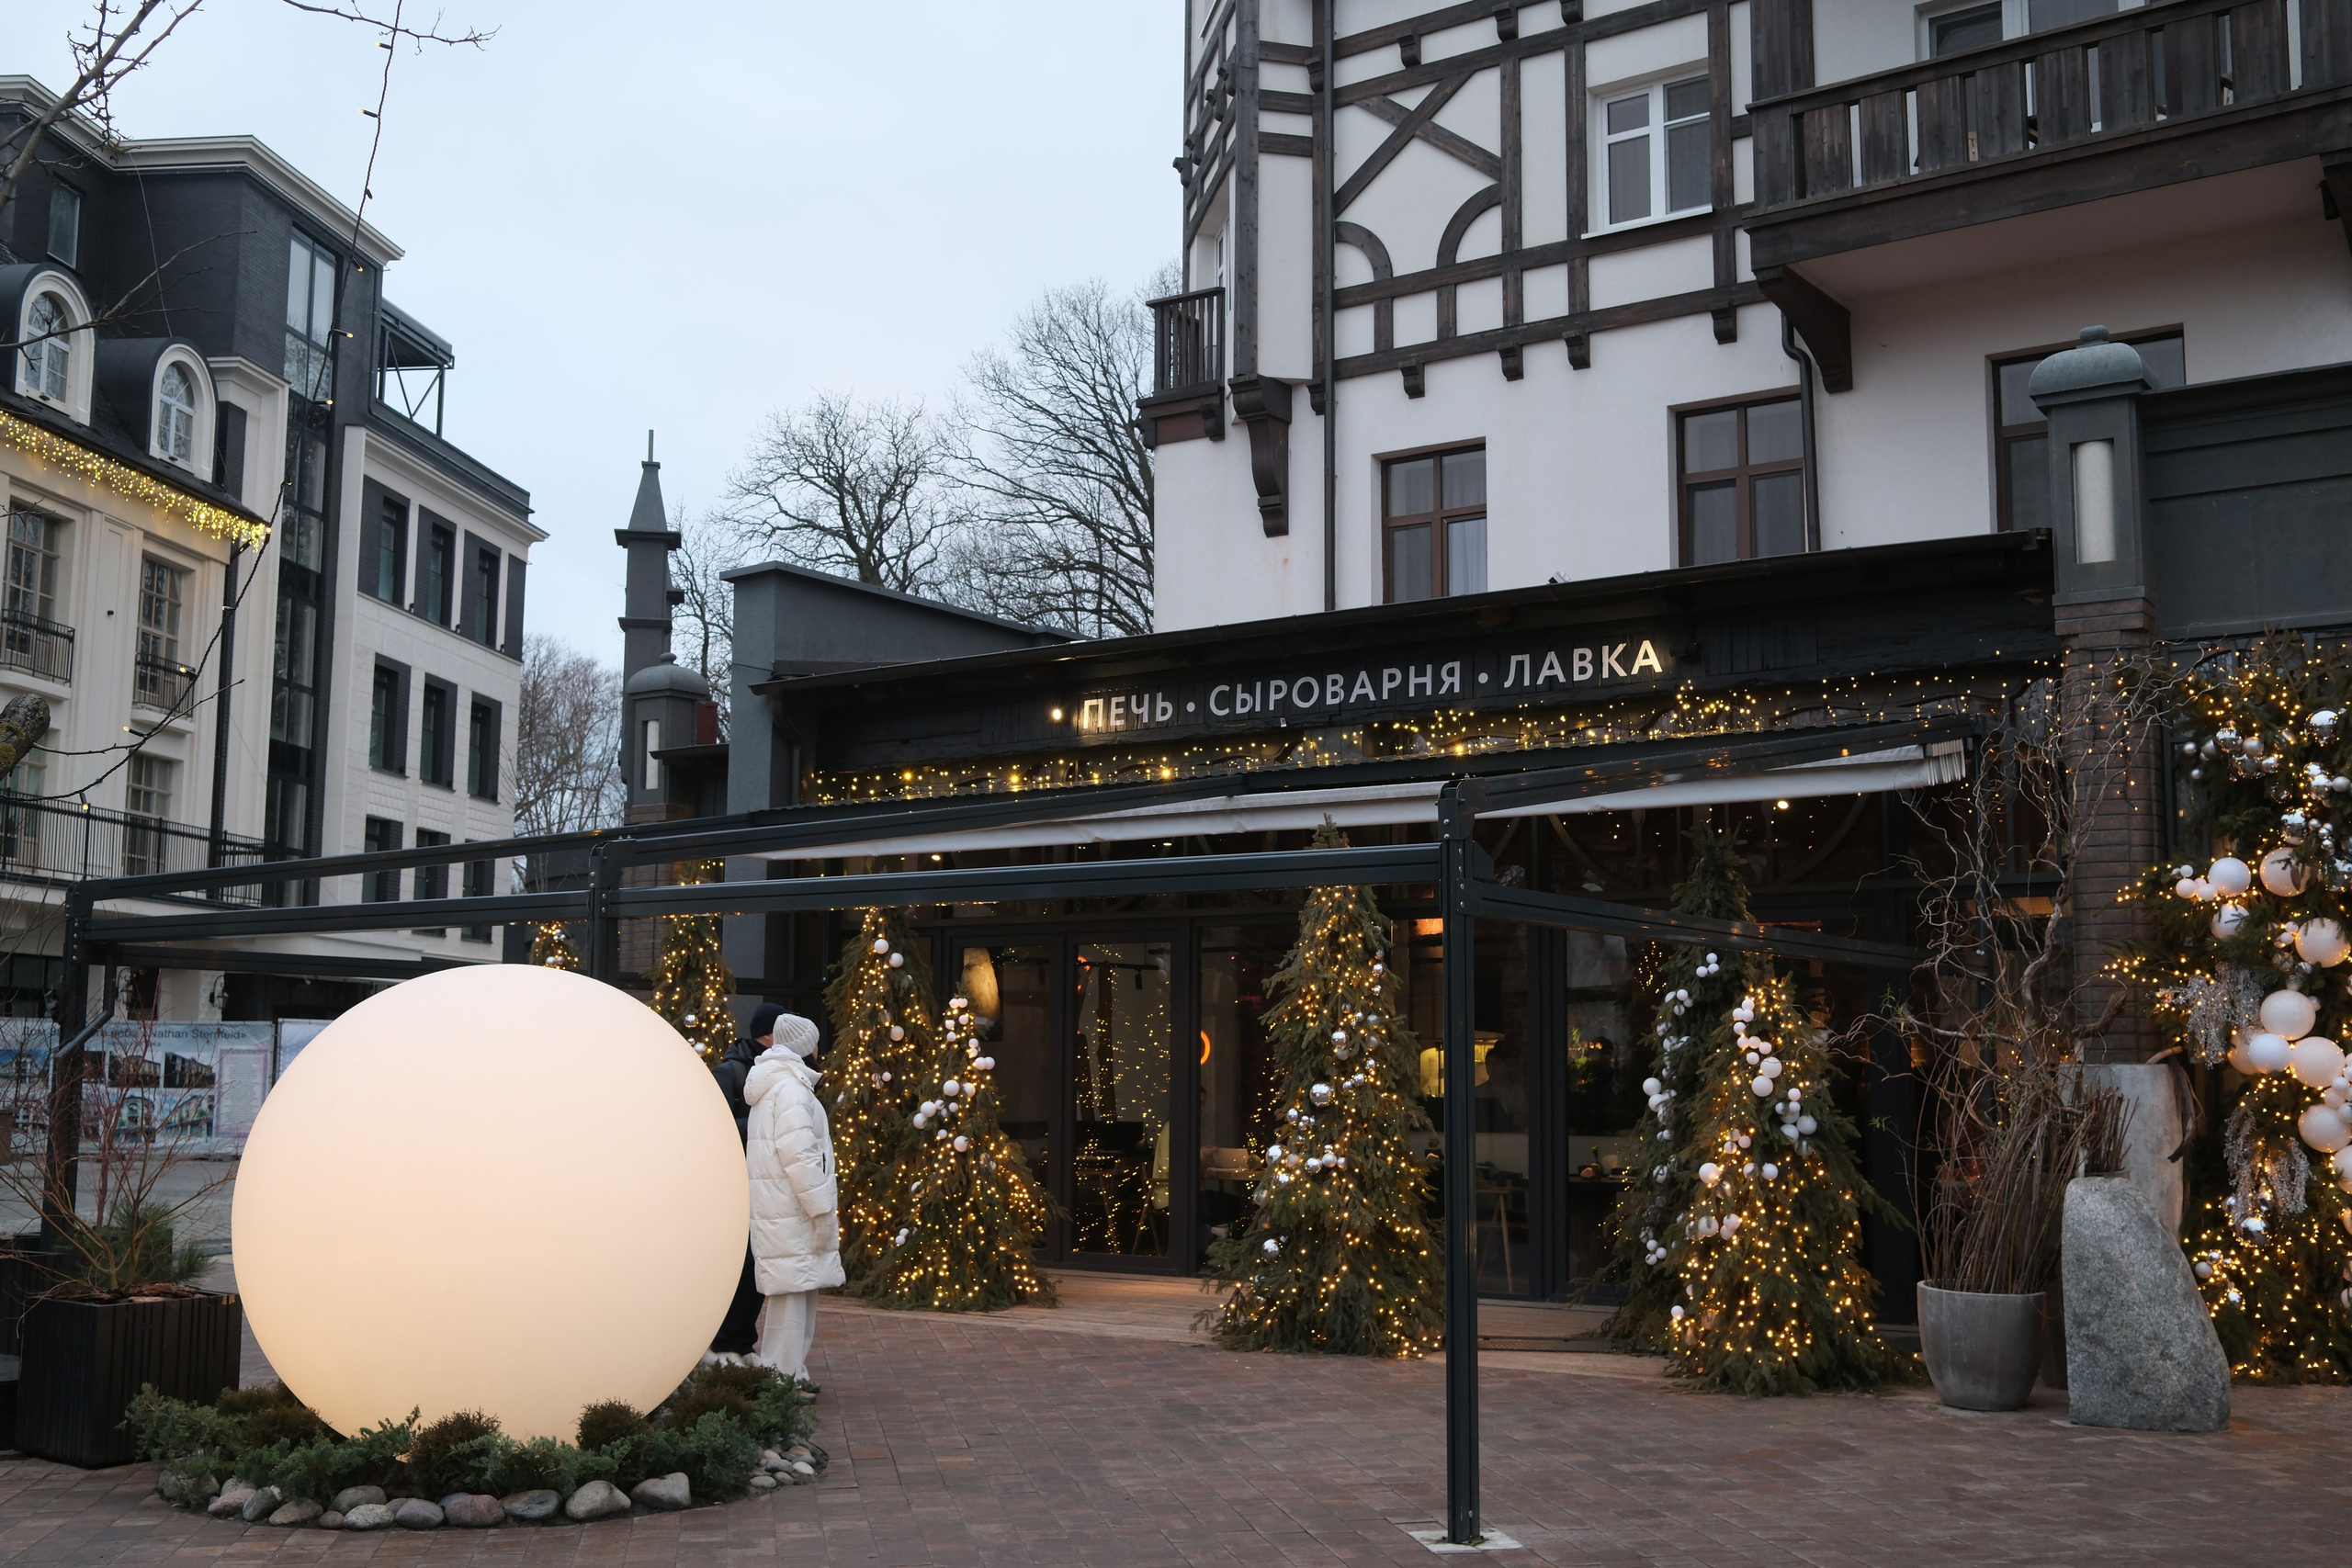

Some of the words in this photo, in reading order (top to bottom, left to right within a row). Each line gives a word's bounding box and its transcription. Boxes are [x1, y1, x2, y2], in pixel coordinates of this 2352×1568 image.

[1083, 692, 1173, 728] ПЕЧЬ
[1209, 660, 1461, 716] СЫРОВАРНЯ
[1503, 639, 1663, 688] ЛАВКА
